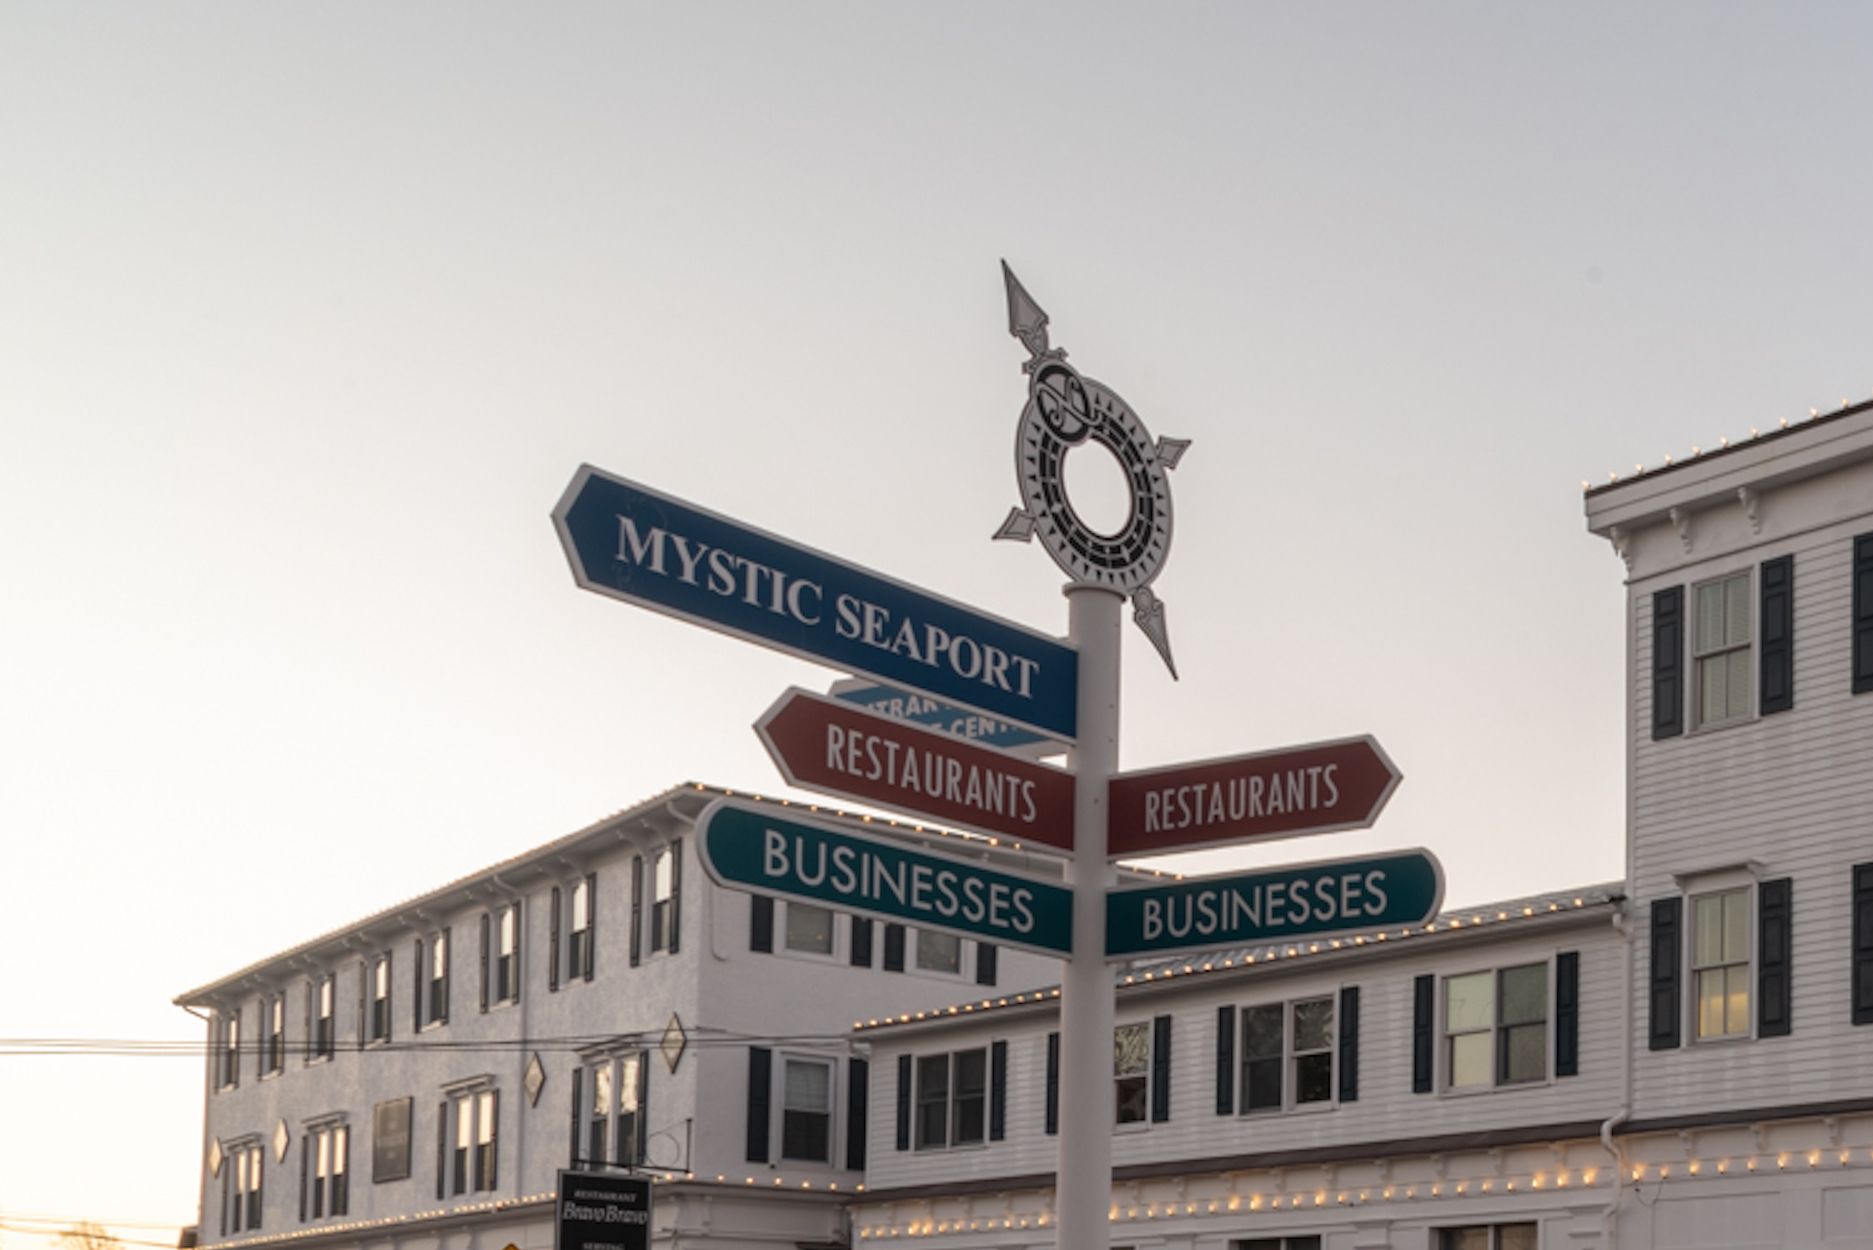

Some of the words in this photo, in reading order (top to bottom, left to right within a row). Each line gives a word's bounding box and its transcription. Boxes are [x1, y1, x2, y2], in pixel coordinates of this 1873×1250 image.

[615, 513, 823, 626] MYSTIC
[835, 593, 1041, 699] SEAPORT
[826, 723, 1037, 823] RESTAURANTS
[1145, 763, 1340, 833] RESTAURANTS
[763, 829, 1035, 934] BUSINESSES
[1143, 870, 1388, 941] BUSINESSES
